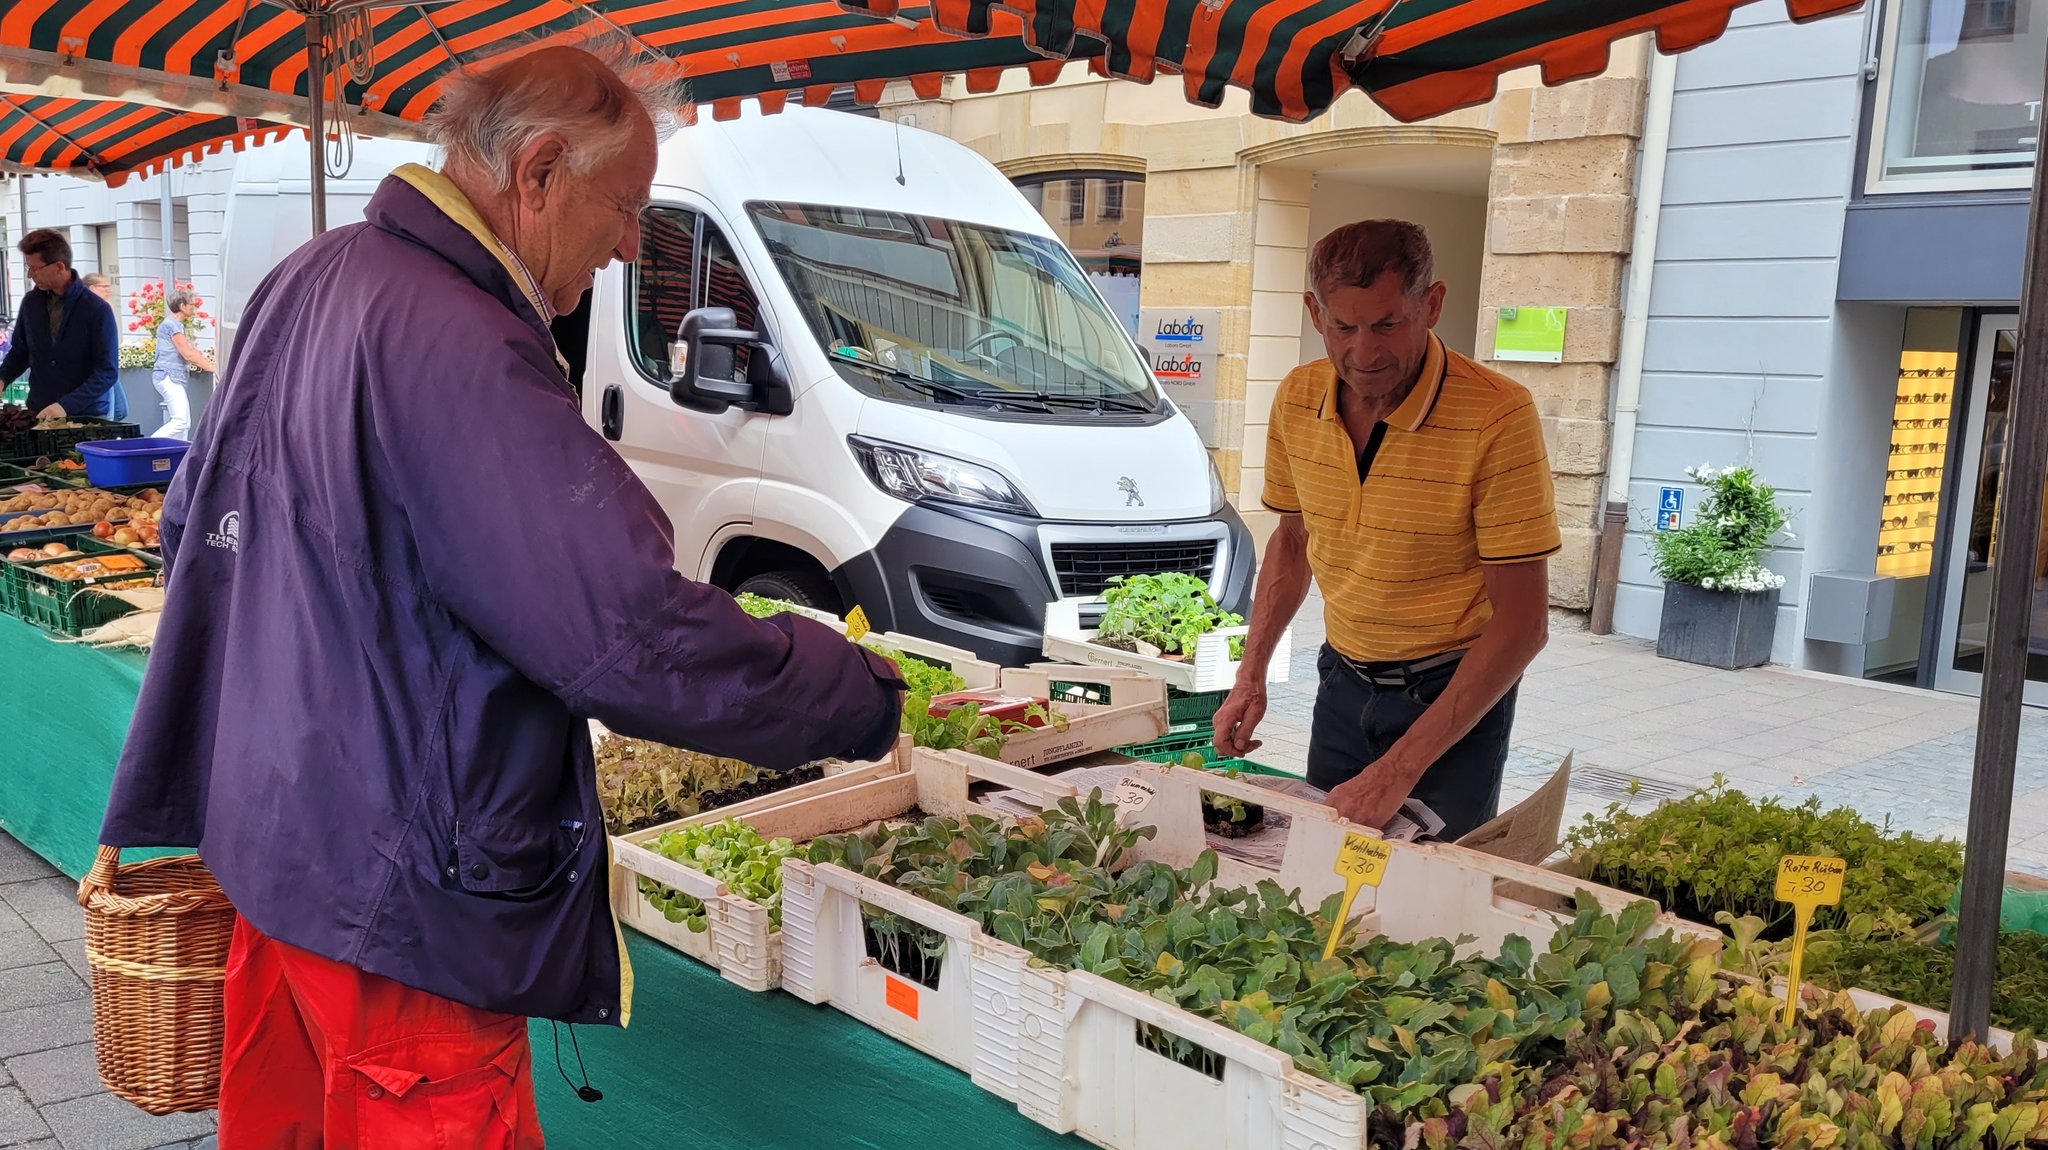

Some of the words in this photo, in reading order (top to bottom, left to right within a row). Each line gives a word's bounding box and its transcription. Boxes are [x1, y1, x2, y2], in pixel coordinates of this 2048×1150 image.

[1157, 318, 1203, 336] Labora
[1155, 355, 1202, 373] Labora
[205, 539, 229, 549] TECH
[1043, 739, 1085, 757] JUNGPFLANZEN
[1782, 858, 1811, 873] Rote
